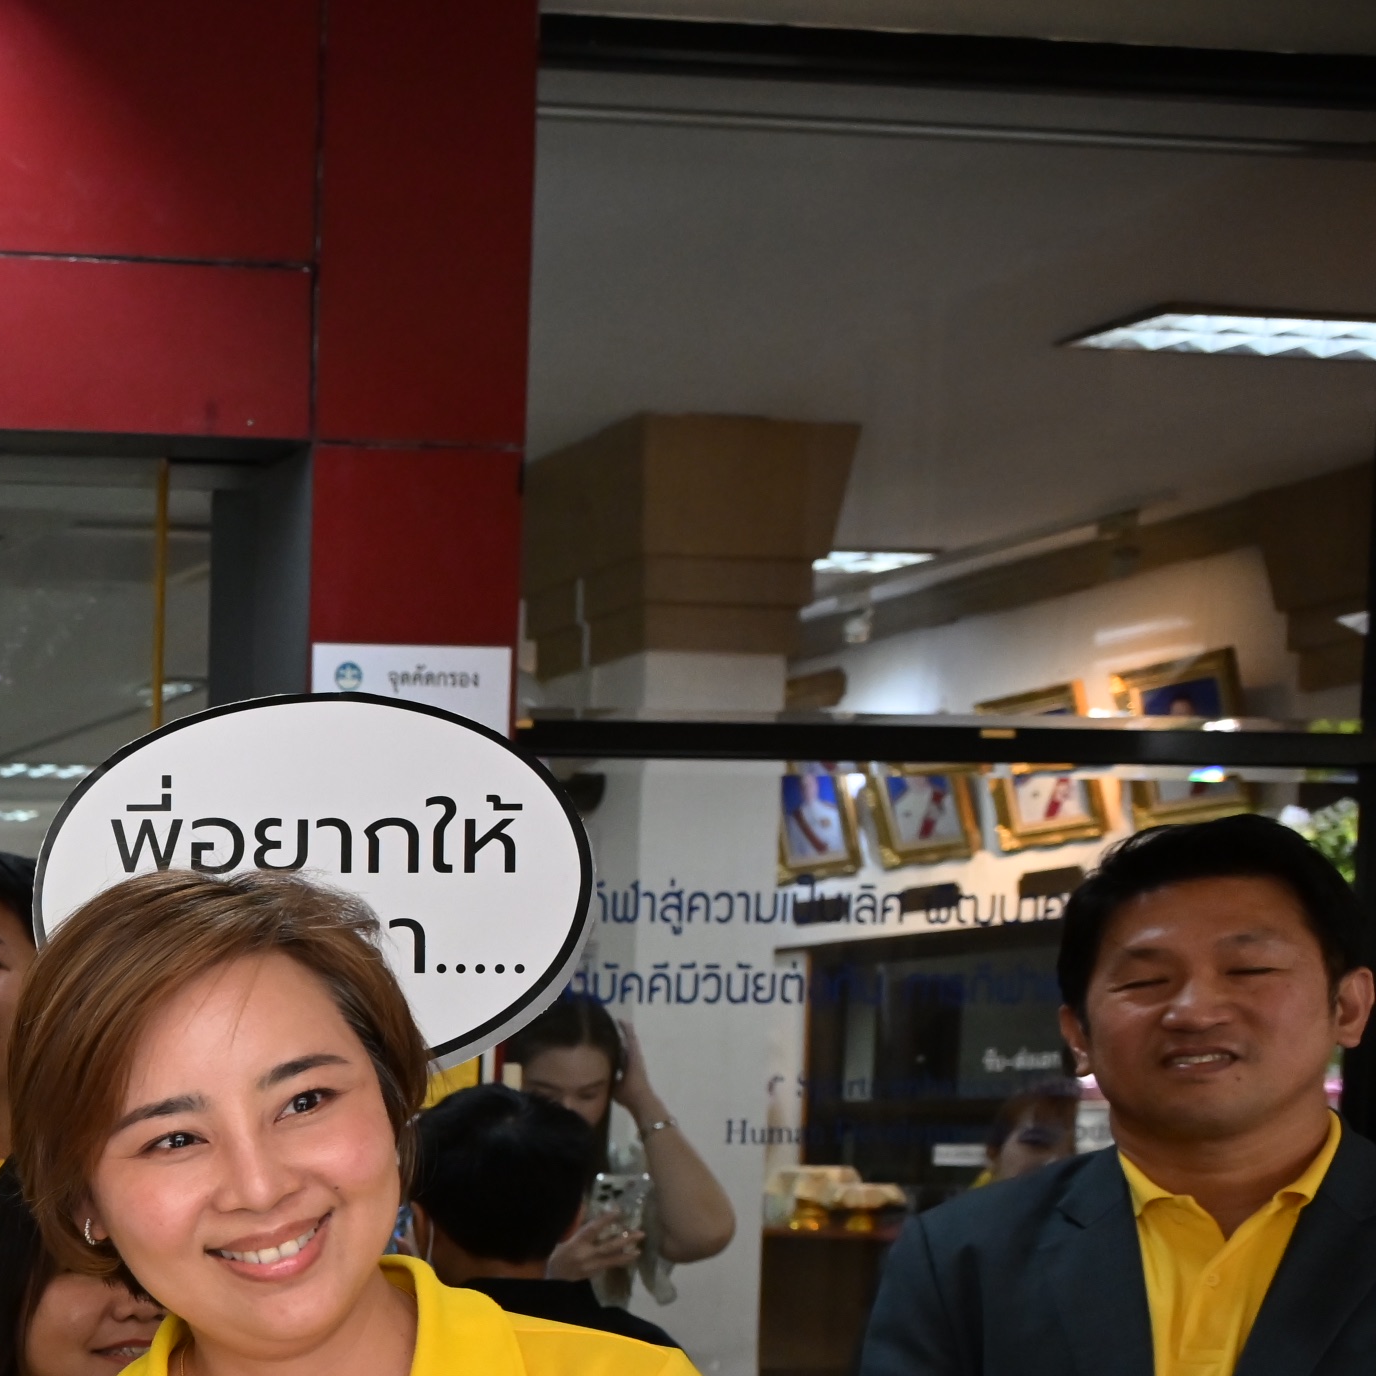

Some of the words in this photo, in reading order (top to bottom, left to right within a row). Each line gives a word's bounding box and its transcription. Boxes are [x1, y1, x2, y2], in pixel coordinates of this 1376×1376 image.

[386, 663, 480, 693] จุดคัดกรอง
[110, 774, 524, 875] พี่อยากให้
